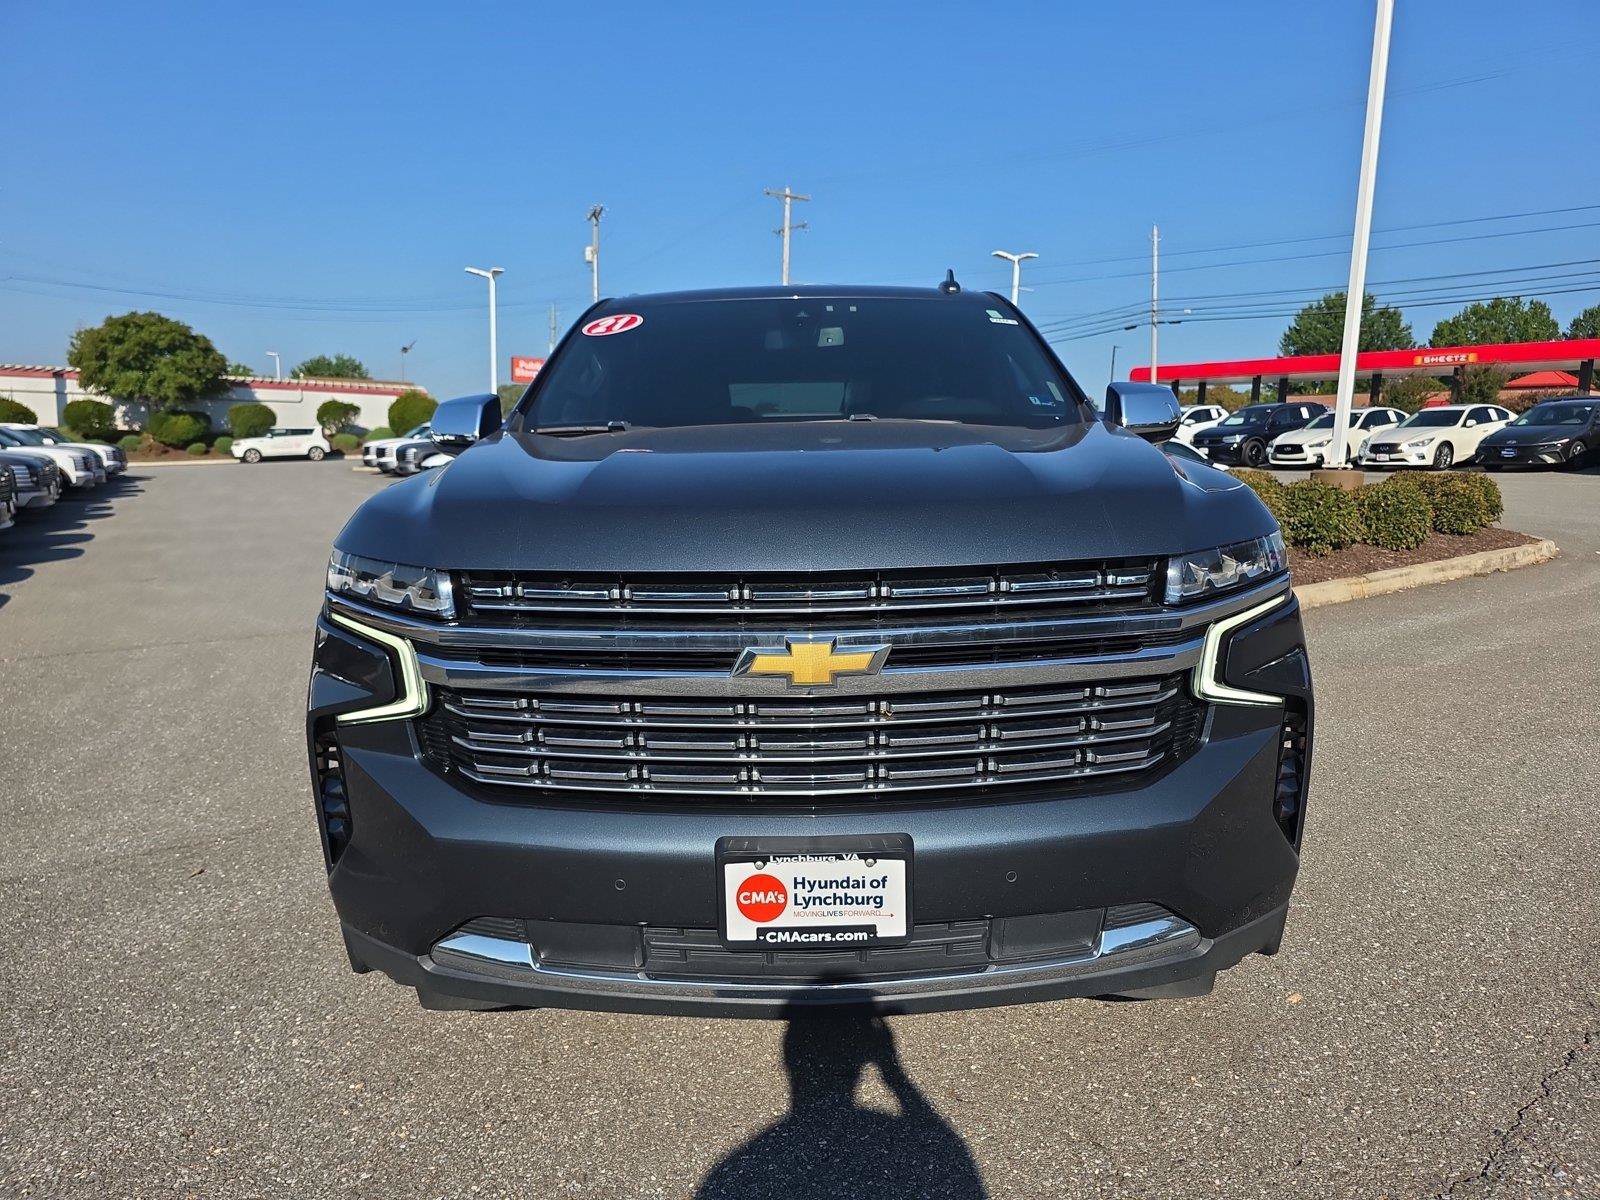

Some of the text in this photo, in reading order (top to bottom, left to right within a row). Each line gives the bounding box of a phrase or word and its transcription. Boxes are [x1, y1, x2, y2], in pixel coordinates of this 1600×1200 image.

[590, 316, 632, 334] 21
[1423, 354, 1467, 364] SHEETZ
[842, 852, 860, 861] VA
[793, 875, 888, 893] Hyundai of
[739, 890, 786, 905] CMA's
[793, 892, 884, 909] Lynchburg
[765, 931, 868, 943] CMAcars.com
